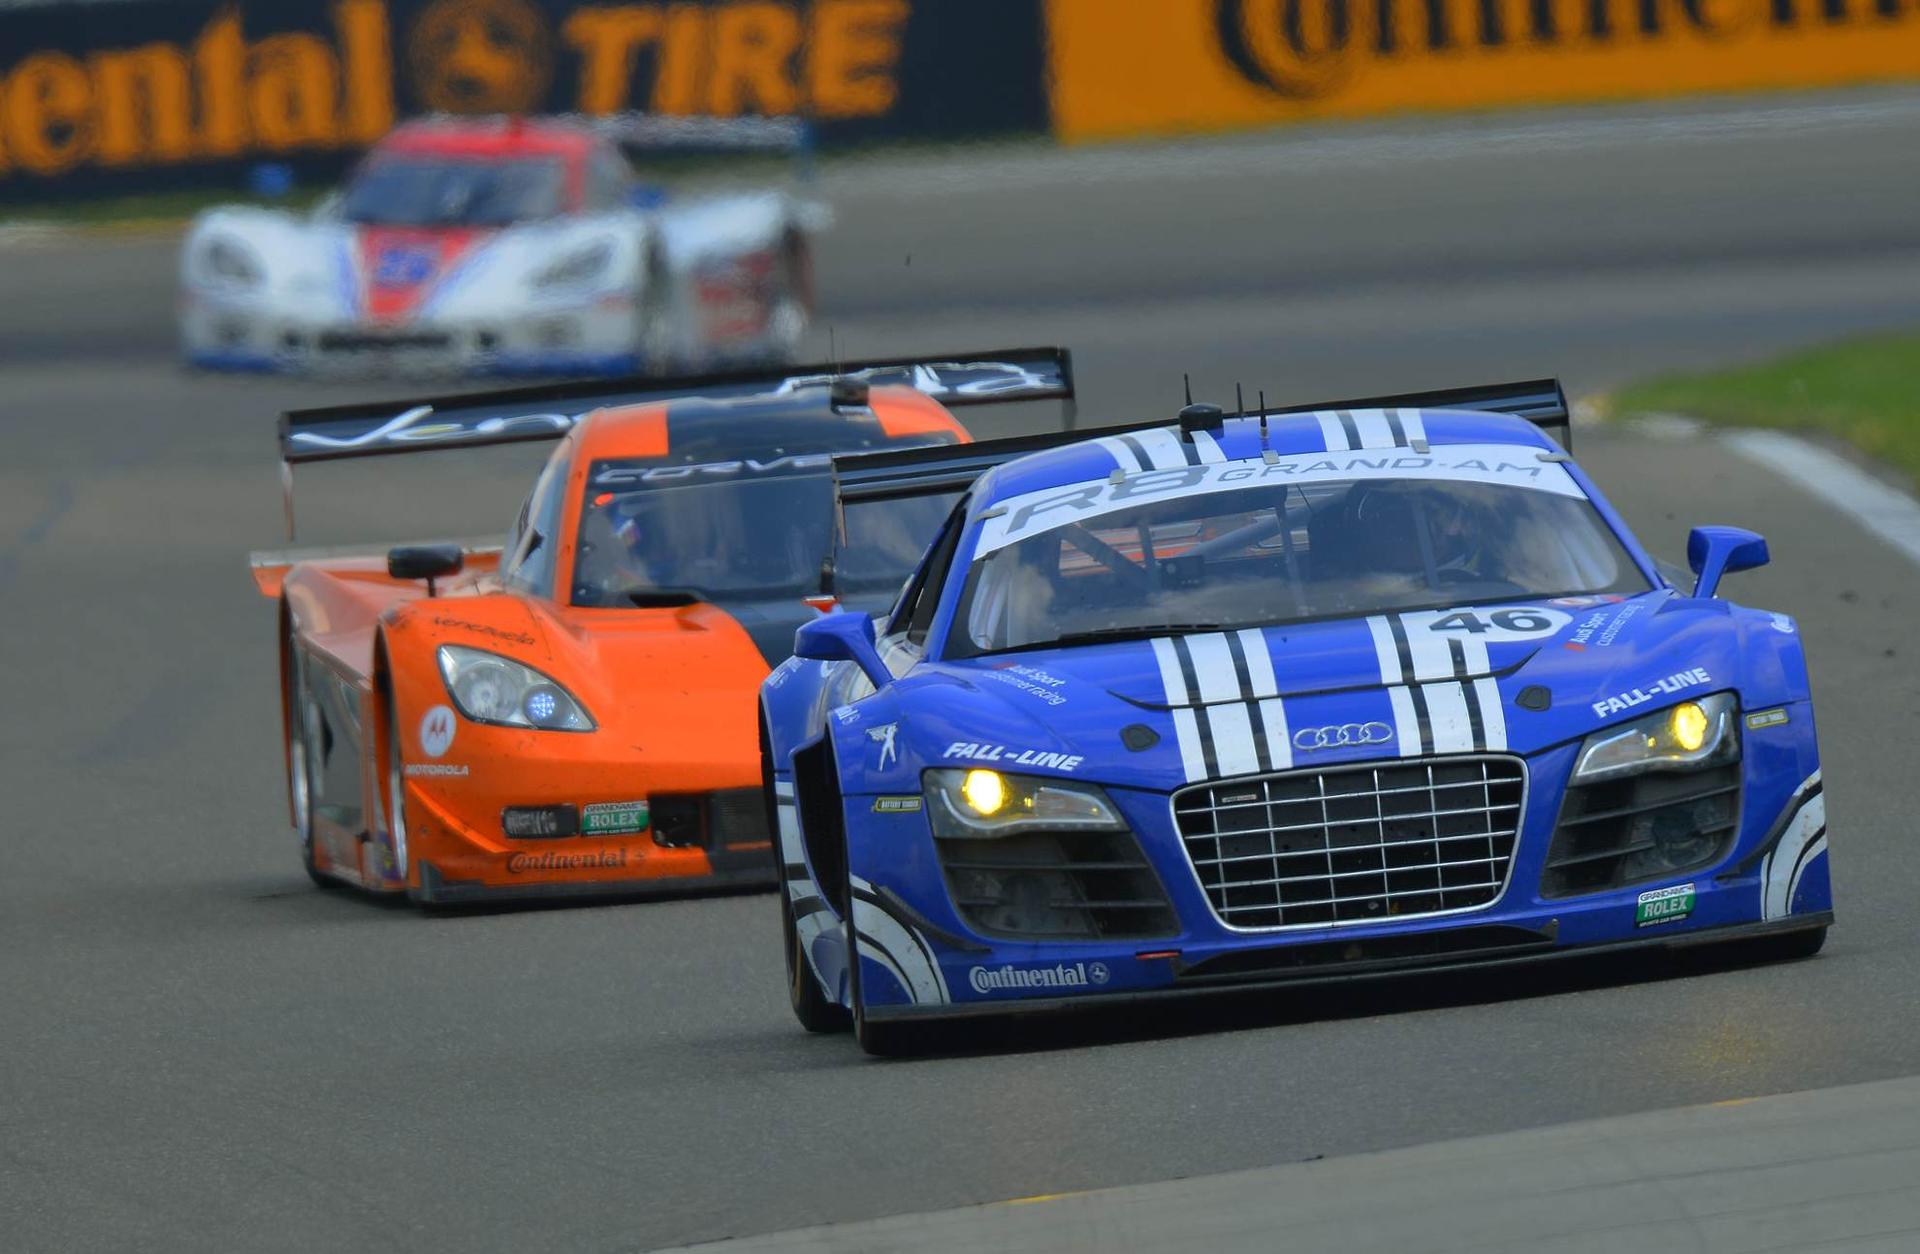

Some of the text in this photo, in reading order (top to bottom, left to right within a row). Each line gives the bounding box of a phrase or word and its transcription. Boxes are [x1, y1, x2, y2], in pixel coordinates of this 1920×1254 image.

[0, 0, 910, 175] ental TIRE
[1429, 609, 1552, 633] 46
[1592, 667, 1712, 718] FALL-LINE
[943, 742, 1084, 771] FALL-LINE
[590, 811, 639, 828] ROLEX
[507, 848, 626, 874] Continental
[1644, 896, 1688, 918] ROLEX
[968, 962, 1088, 994] Continental
